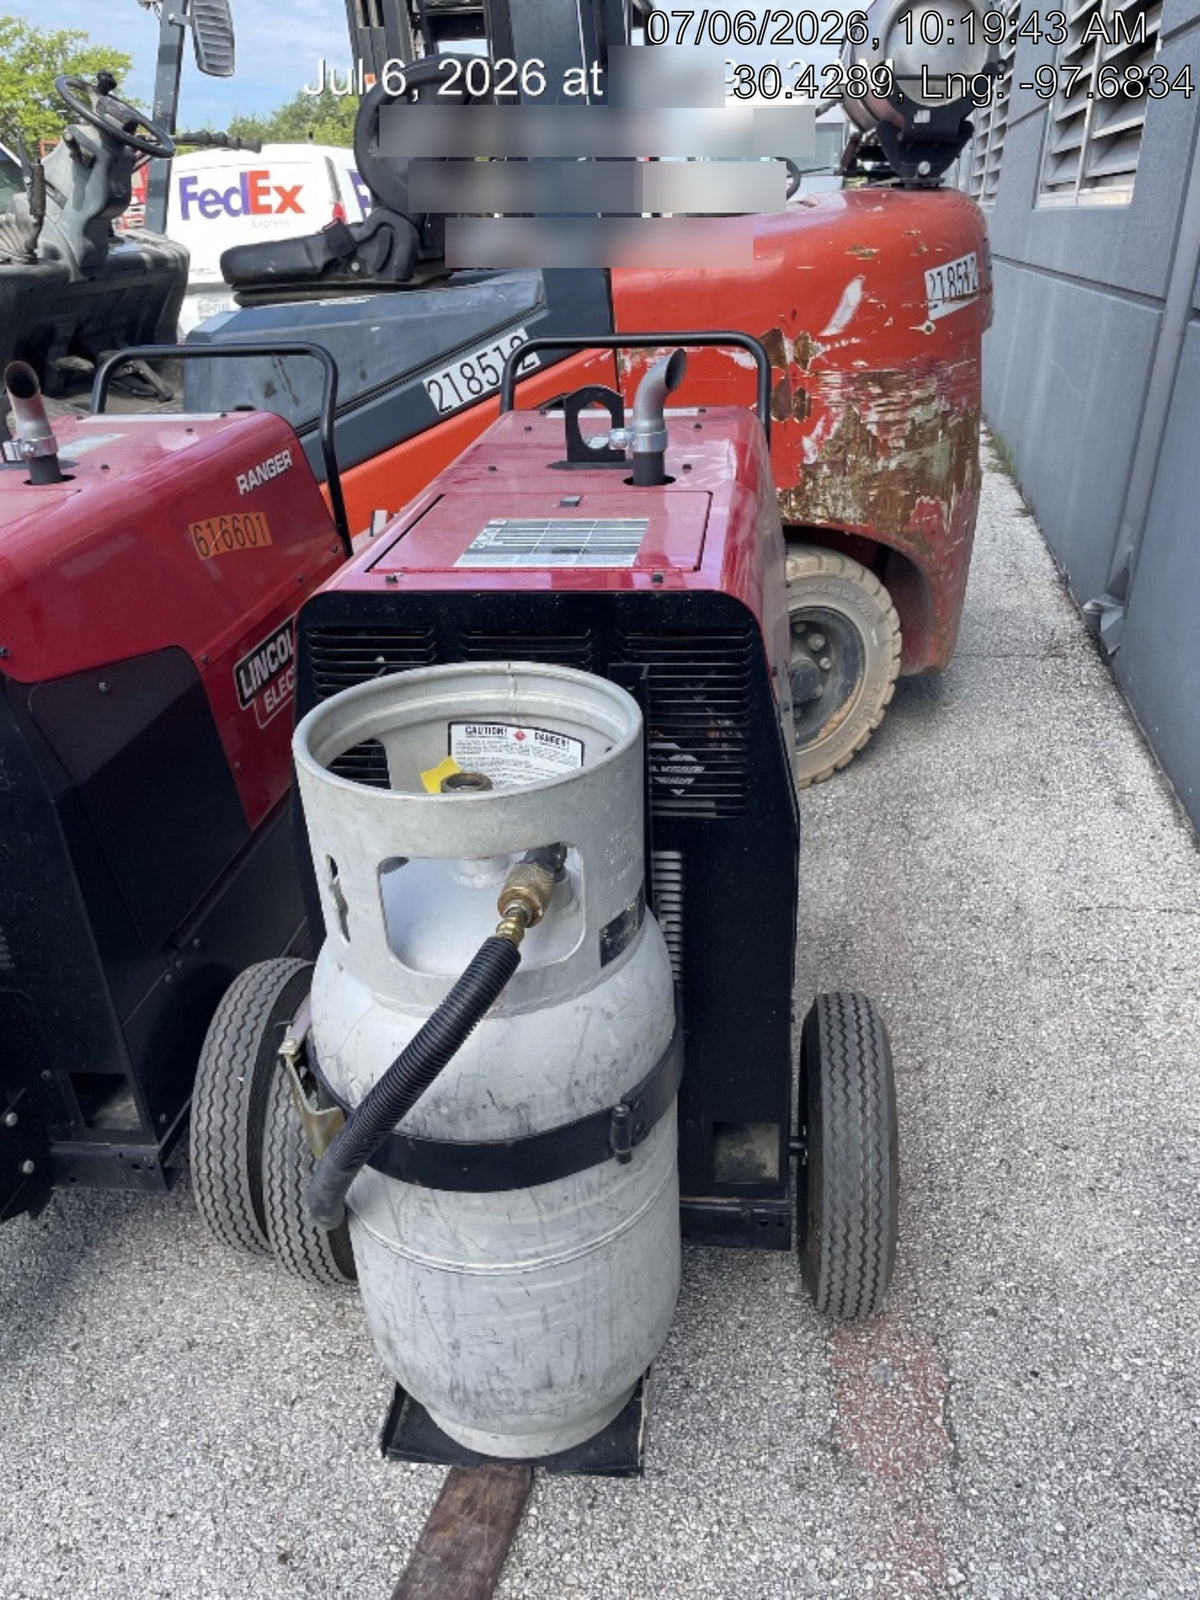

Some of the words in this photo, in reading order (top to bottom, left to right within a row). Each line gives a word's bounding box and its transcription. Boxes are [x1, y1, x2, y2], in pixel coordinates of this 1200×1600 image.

[179, 169, 306, 221] FedEx
[235, 449, 293, 496] RANGER
[193, 515, 267, 557] 616601
[465, 726, 508, 736] CAUTION!
